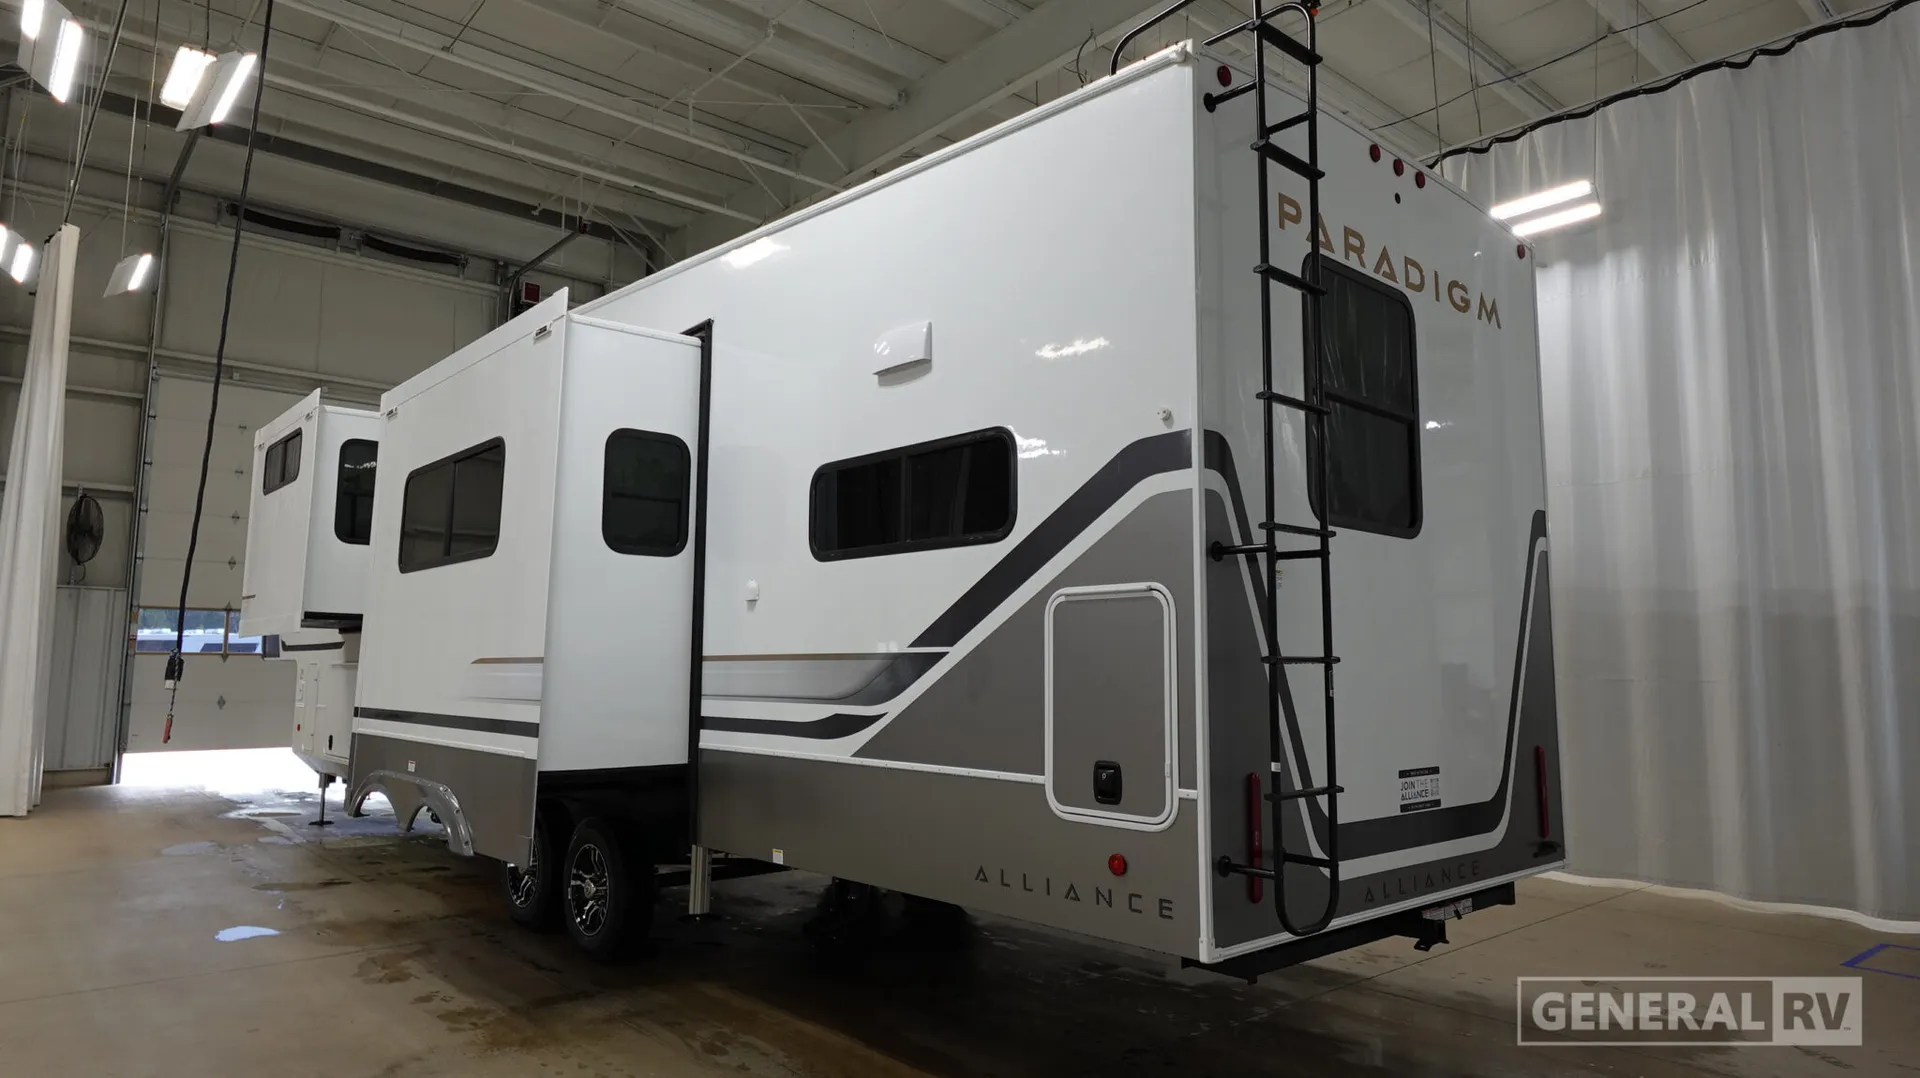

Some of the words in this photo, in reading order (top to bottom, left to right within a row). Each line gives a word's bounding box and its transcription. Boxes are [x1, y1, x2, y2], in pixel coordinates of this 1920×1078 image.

[1278, 192, 1502, 330] PARADIGM
[1400, 780, 1415, 791] JOIN
[1401, 789, 1429, 801] ALLIANCE
[974, 864, 1174, 920] ALLIANCE
[1364, 860, 1481, 904] ALLIANCE
